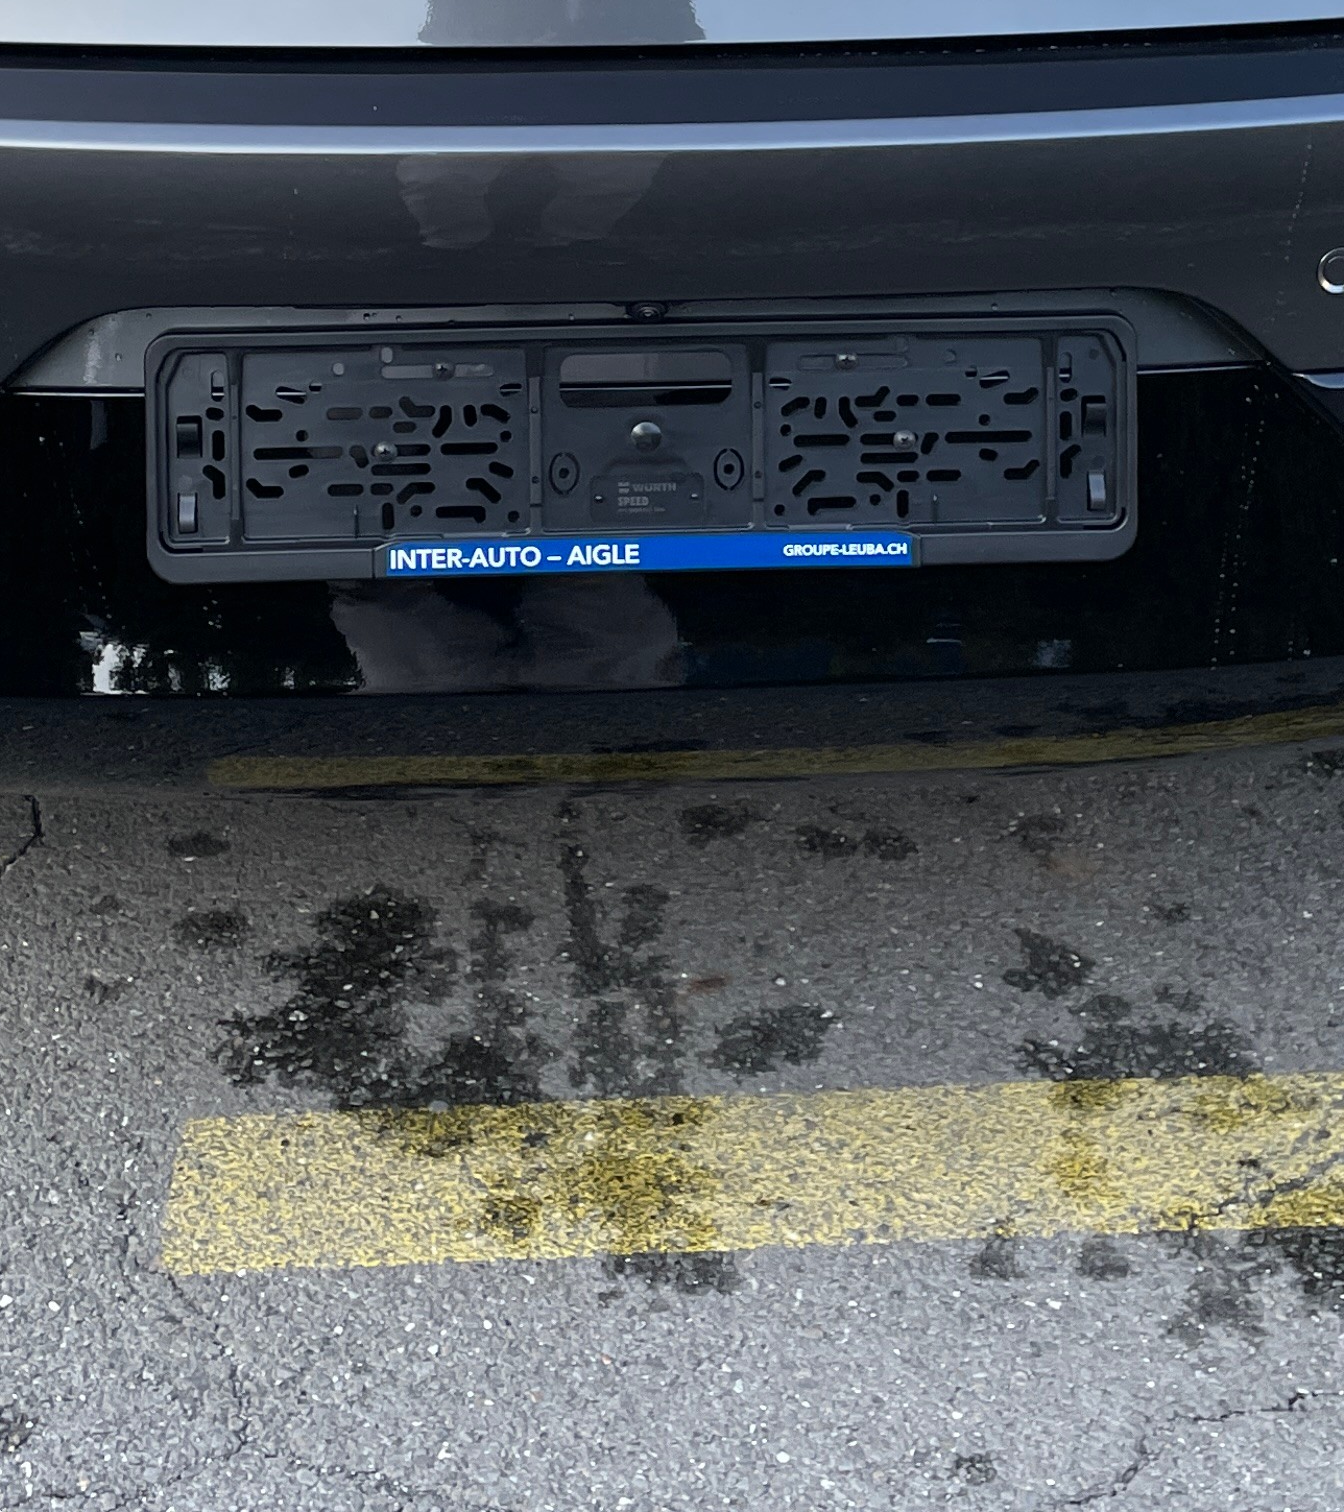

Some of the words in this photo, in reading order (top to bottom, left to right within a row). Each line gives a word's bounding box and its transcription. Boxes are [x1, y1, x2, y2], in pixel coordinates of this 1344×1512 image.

[617, 496, 649, 507] SPEED
[390, 546, 542, 570] INTER-AUTO
[567, 543, 641, 566] AIGLE
[783, 543, 908, 557] GROUPE-LEUBA.CH
